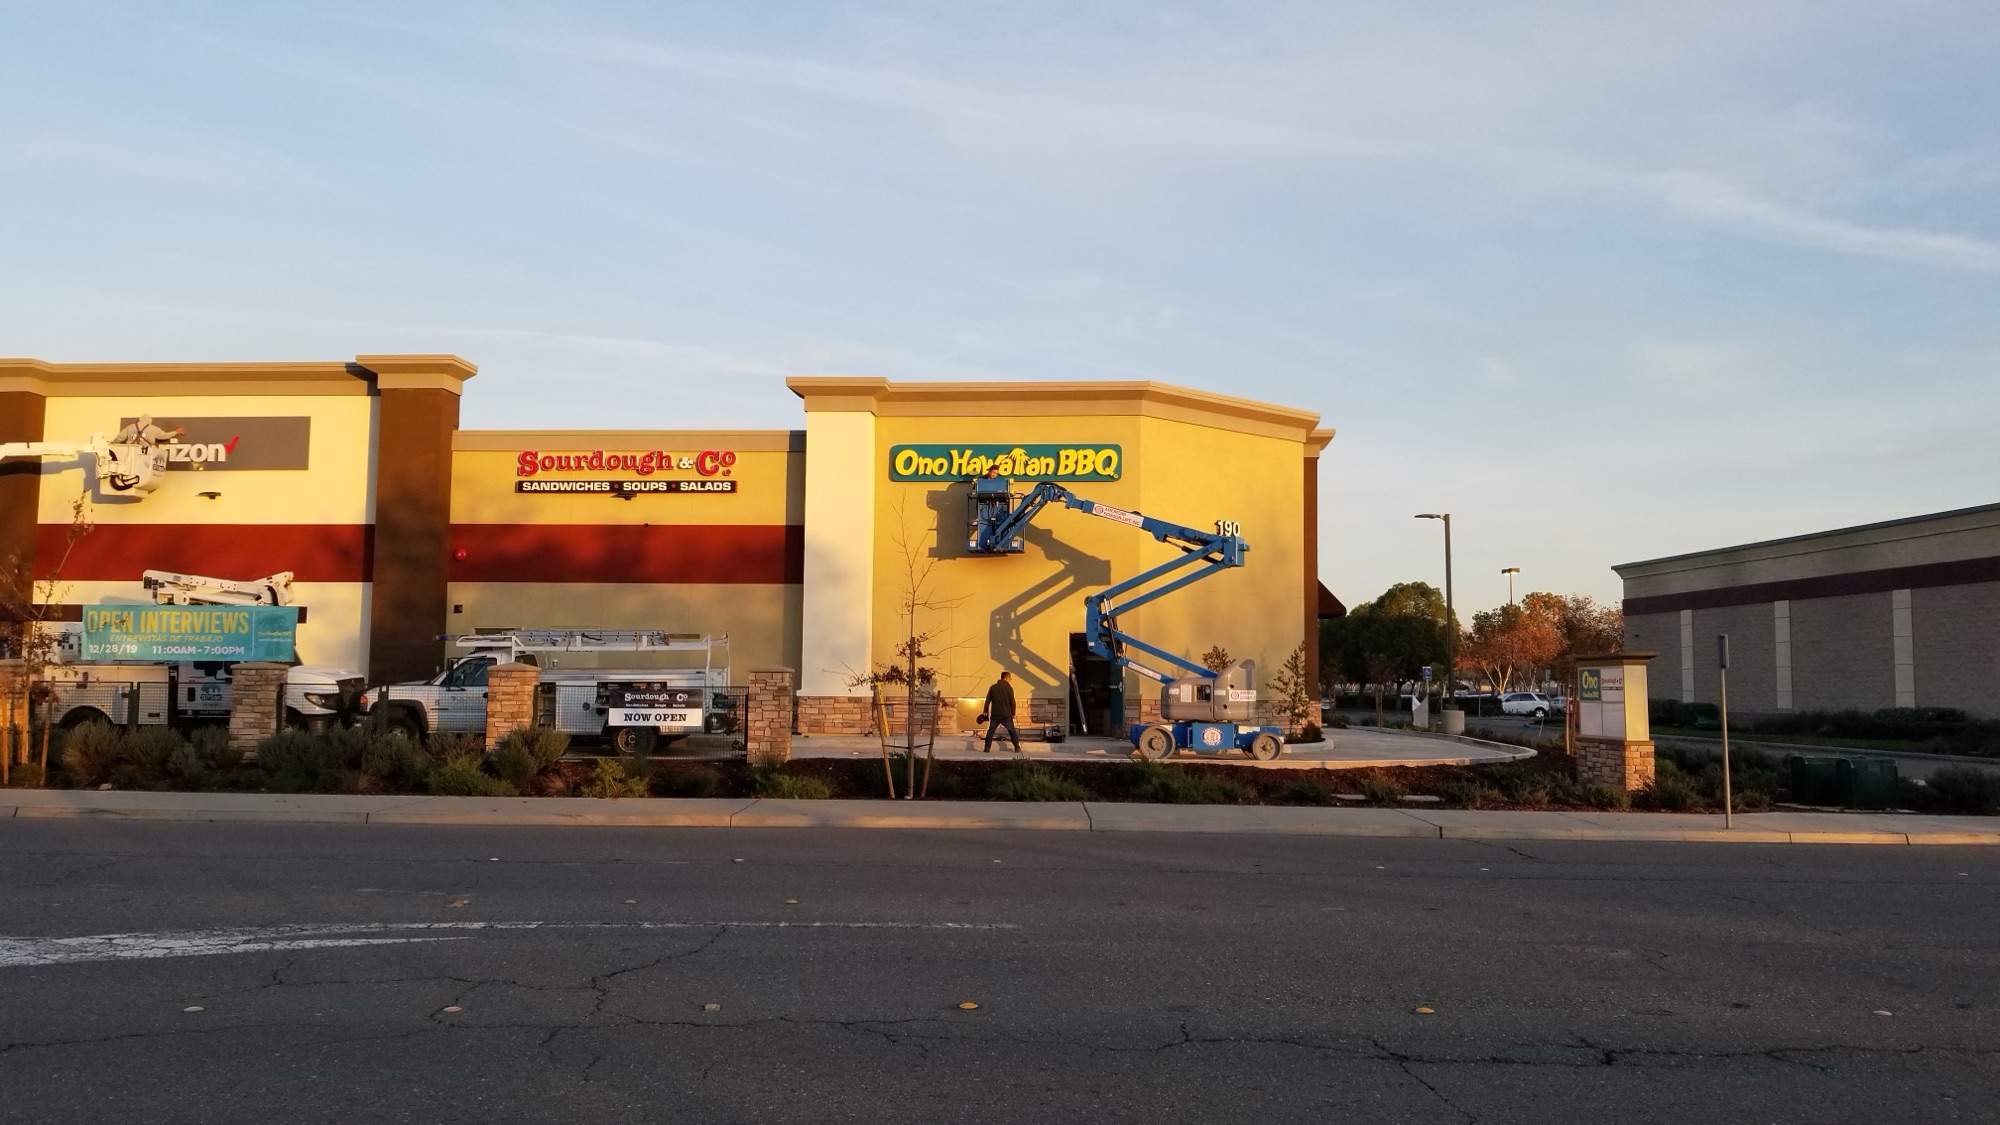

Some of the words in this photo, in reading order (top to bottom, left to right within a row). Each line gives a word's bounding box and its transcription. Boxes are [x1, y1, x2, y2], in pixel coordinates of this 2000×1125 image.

[518, 450, 673, 476] Sourdough
[679, 456, 694, 469] &
[895, 449, 948, 476] Ono
[1057, 448, 1118, 478] BBQ
[522, 482, 610, 491] SANDWICHES
[623, 482, 667, 491] SOUPS
[680, 482, 731, 491] SALADS
[1216, 520, 1241, 537] 190
[86, 610, 134, 633] OPEN
[140, 610, 249, 634] INTERVIEWS
[89, 644, 138, 654] 12/28/19
[1582, 671, 1598, 689] Ono
[625, 693, 669, 702] Sourdough
[624, 713, 652, 722] NOW
[655, 713, 687, 722] OPEN
